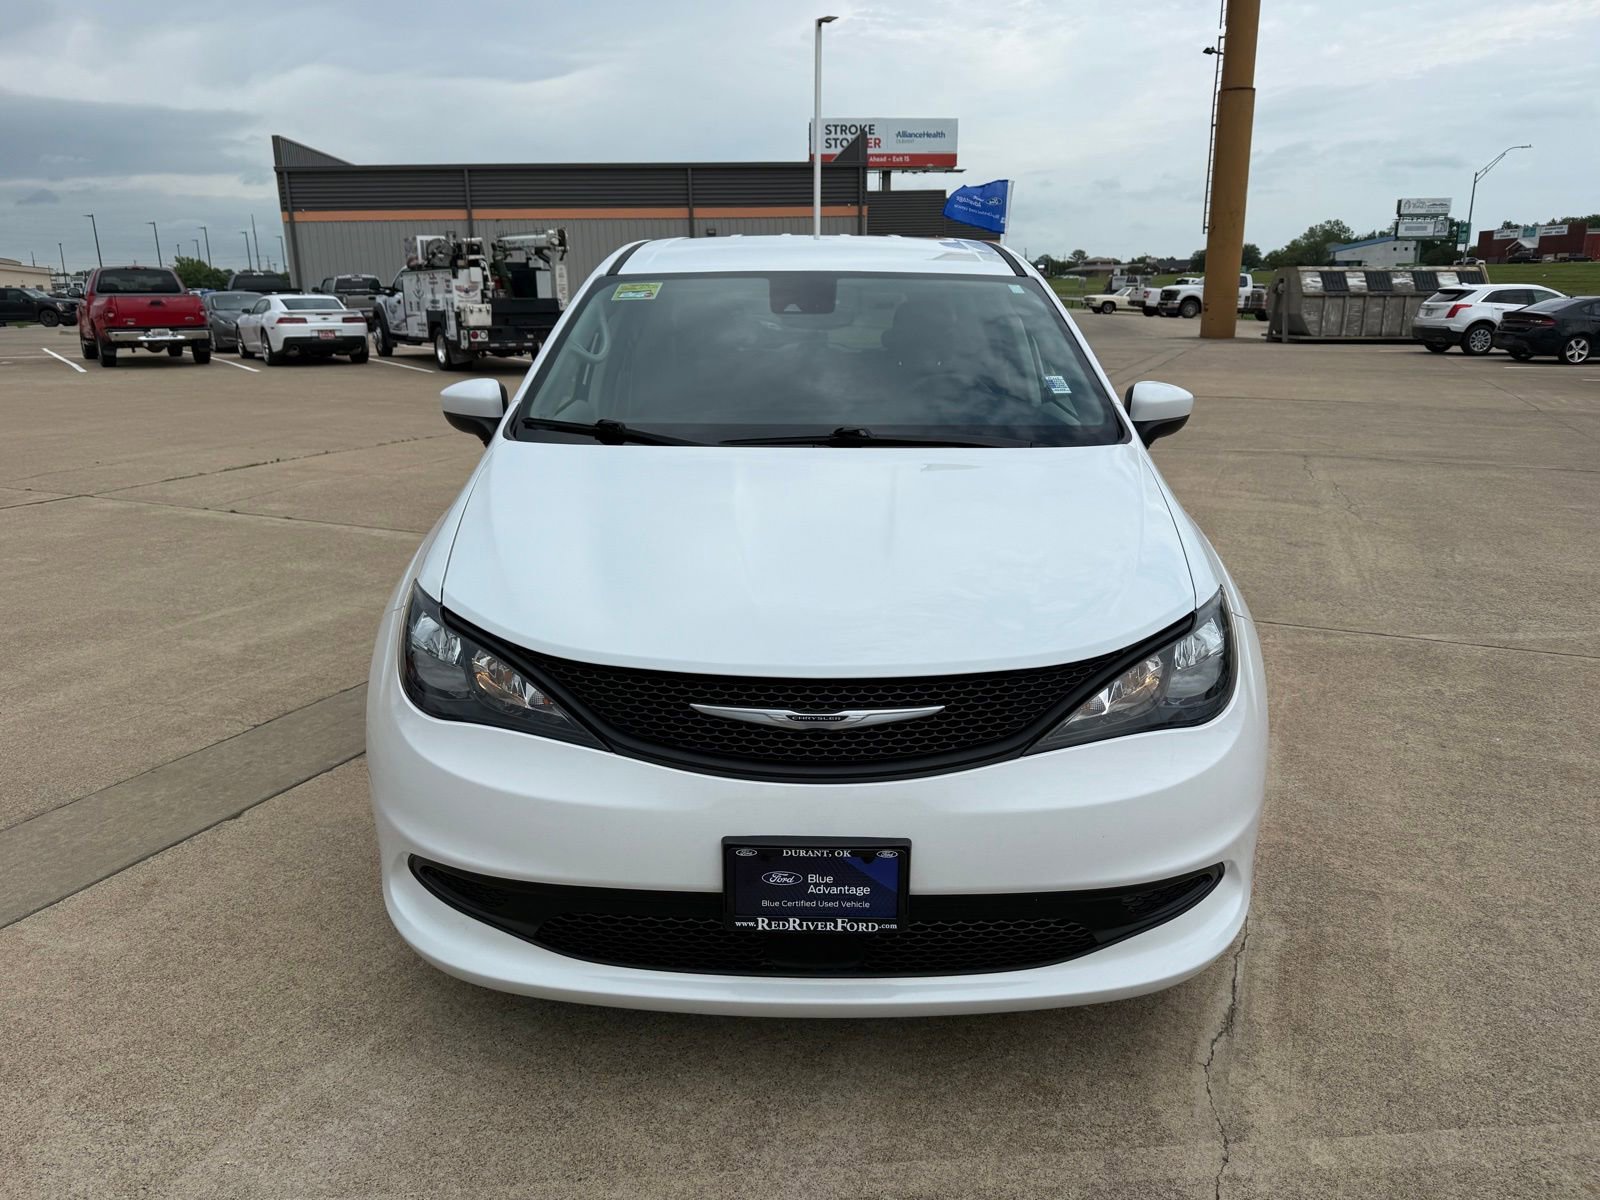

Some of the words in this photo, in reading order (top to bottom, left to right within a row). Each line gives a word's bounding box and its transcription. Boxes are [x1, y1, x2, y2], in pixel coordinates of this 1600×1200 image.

[825, 124, 875, 135] STROKE
[896, 130, 946, 139] AllianceHealth
[825, 138, 881, 149] STOER
[783, 849, 831, 858] DURANT,
[835, 849, 851, 858] OK
[768, 872, 796, 884] Ford
[808, 874, 834, 884] Blue
[808, 885, 870, 896] Advantage
[762, 900, 780, 908] Blue
[782, 900, 816, 908] Certified
[818, 900, 839, 908] Used
[841, 900, 870, 908] Vehicle
